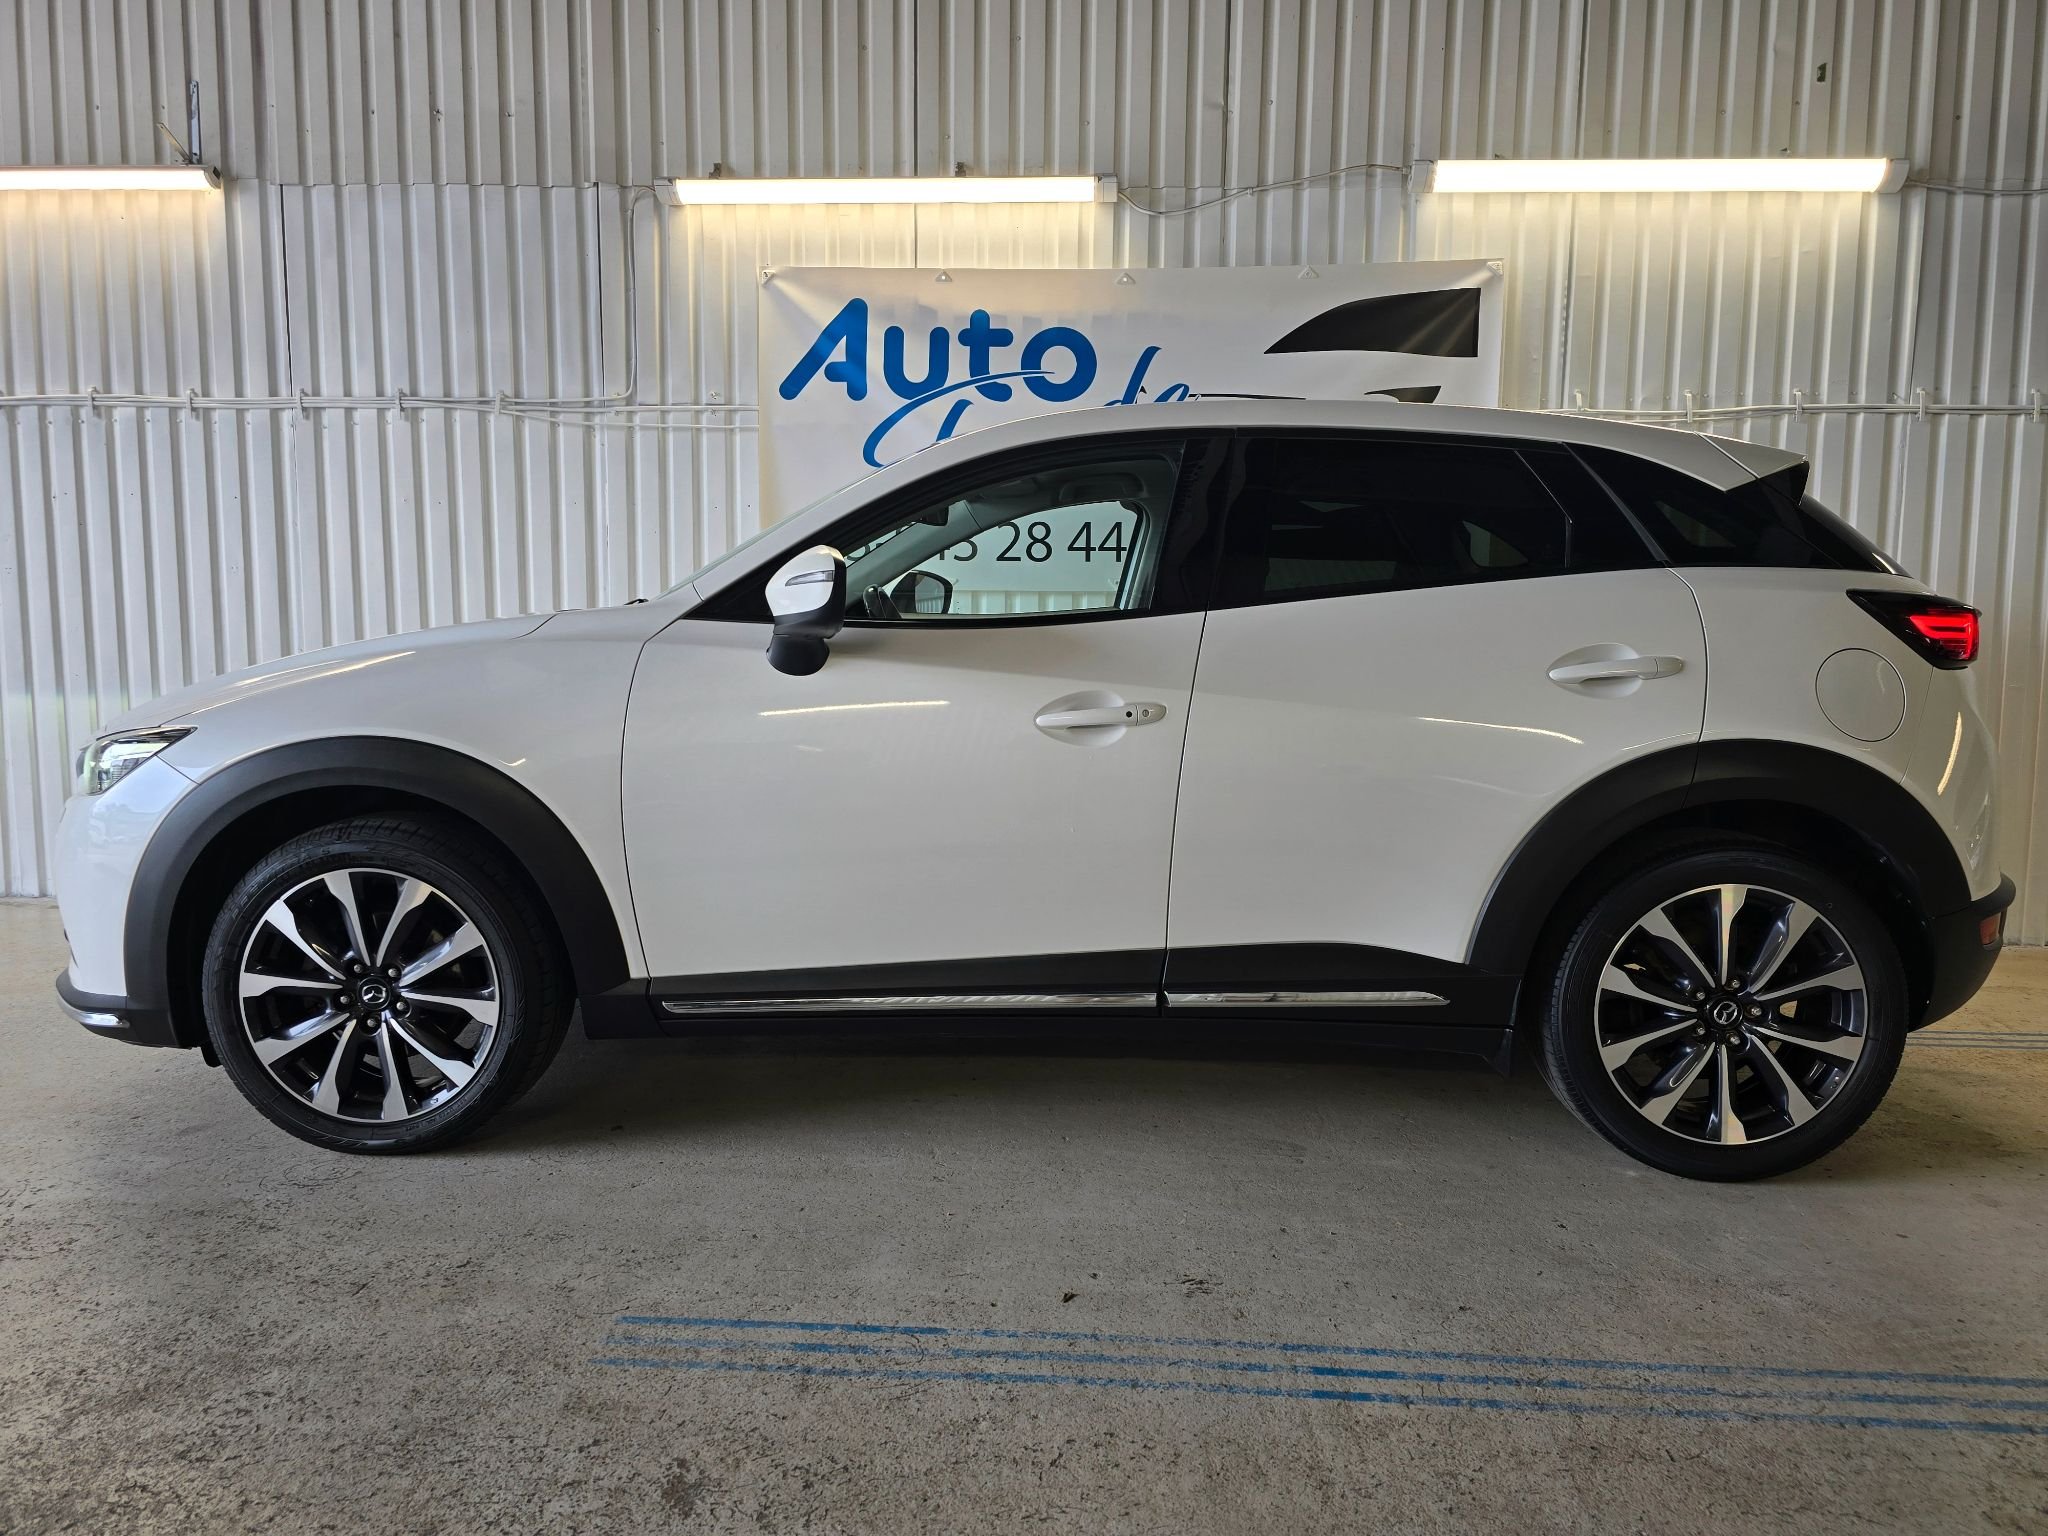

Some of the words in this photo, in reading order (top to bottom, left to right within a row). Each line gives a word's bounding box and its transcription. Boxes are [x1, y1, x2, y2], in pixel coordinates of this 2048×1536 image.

[779, 298, 1098, 402] Auto
[995, 521, 1053, 562] 28
[1067, 521, 1128, 562] 44
